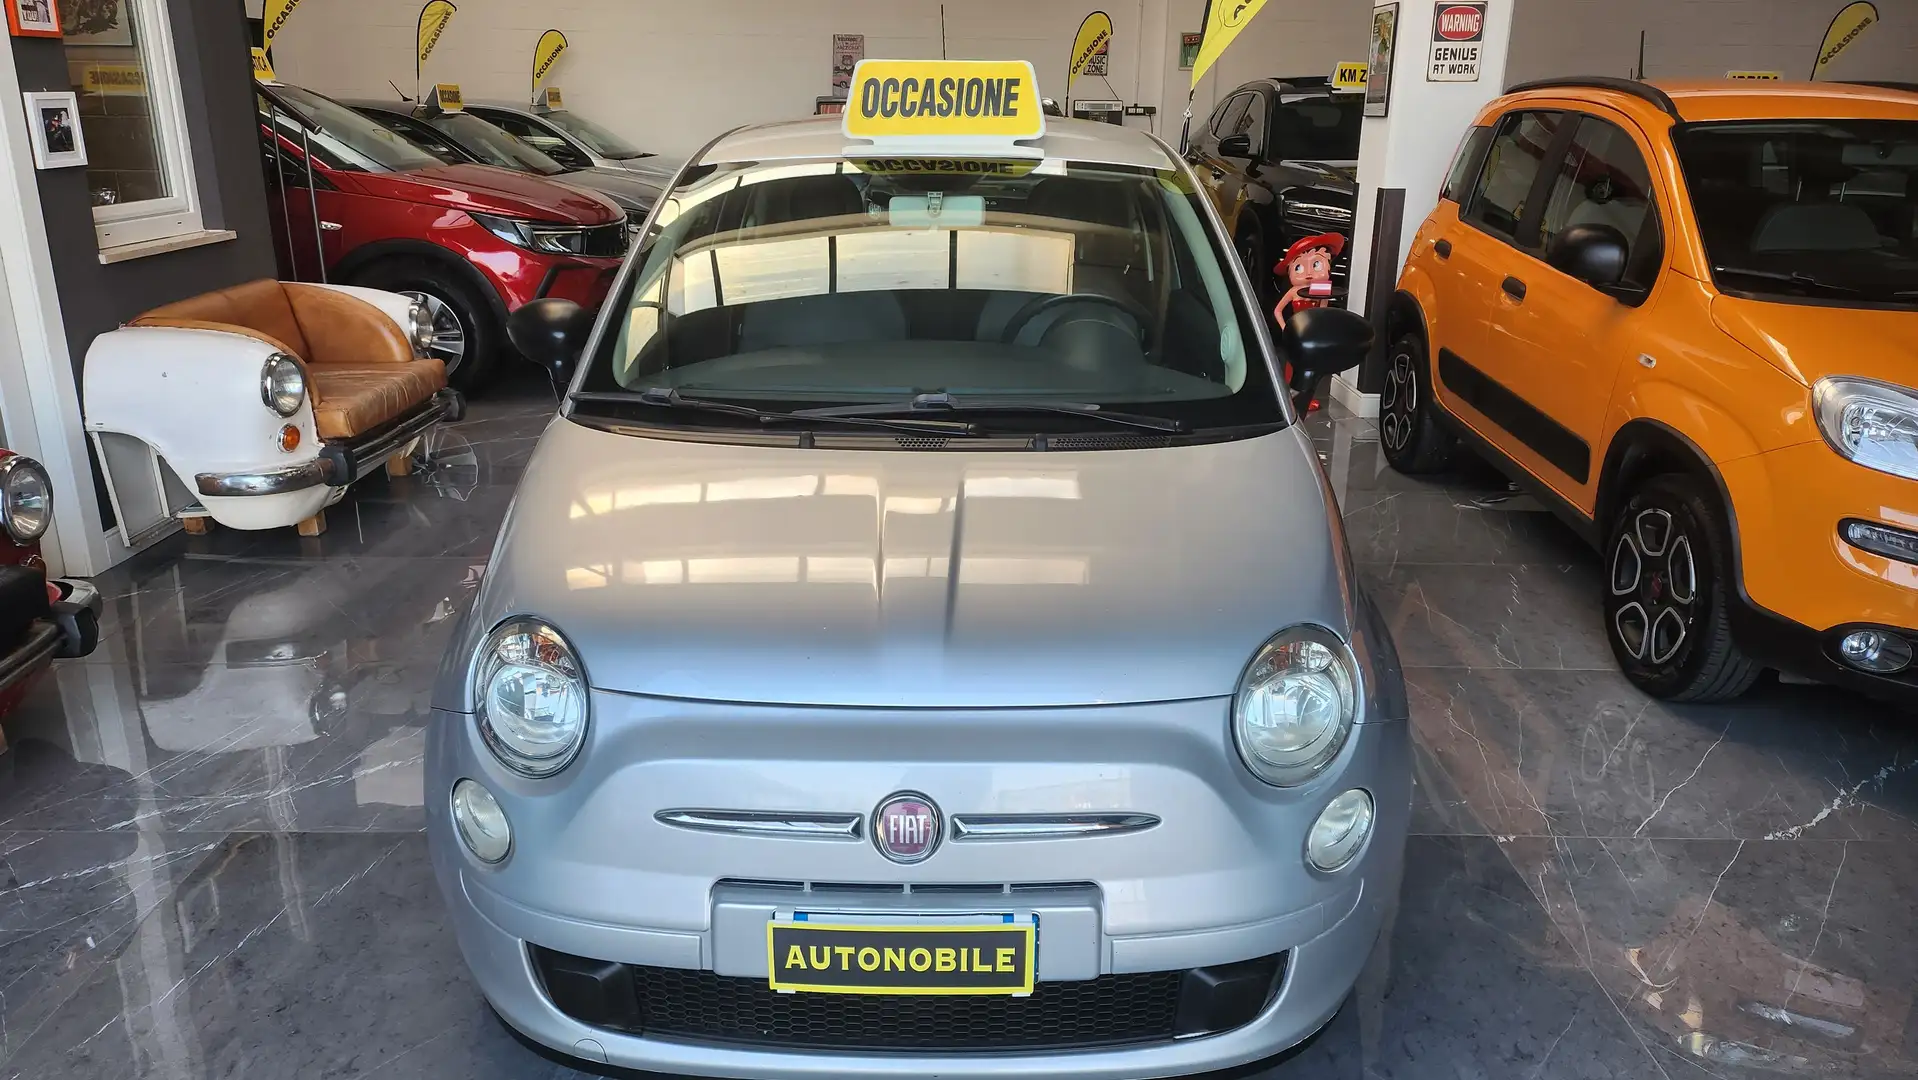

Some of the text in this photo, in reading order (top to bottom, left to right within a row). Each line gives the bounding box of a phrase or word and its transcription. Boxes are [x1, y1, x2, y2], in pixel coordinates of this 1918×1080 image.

[267, 0, 300, 39] OCCASI
[1441, 13, 1480, 32] WARNING
[421, 10, 452, 60] OCCASIONE
[1820, 17, 1872, 65] OCCASIONE
[536, 44, 564, 78] OCCASIONE
[1072, 29, 1108, 74] OCCASIONE
[1435, 48, 1478, 61] GENIUS
[1087, 65, 1104, 73] ZONE
[1340, 69, 1356, 82] KM
[1433, 64, 1476, 75] AT WORK
[862, 77, 1020, 118] OCCASIONE
[889, 814, 928, 844] FIAT
[785, 945, 1016, 973] AUTONOBILE
